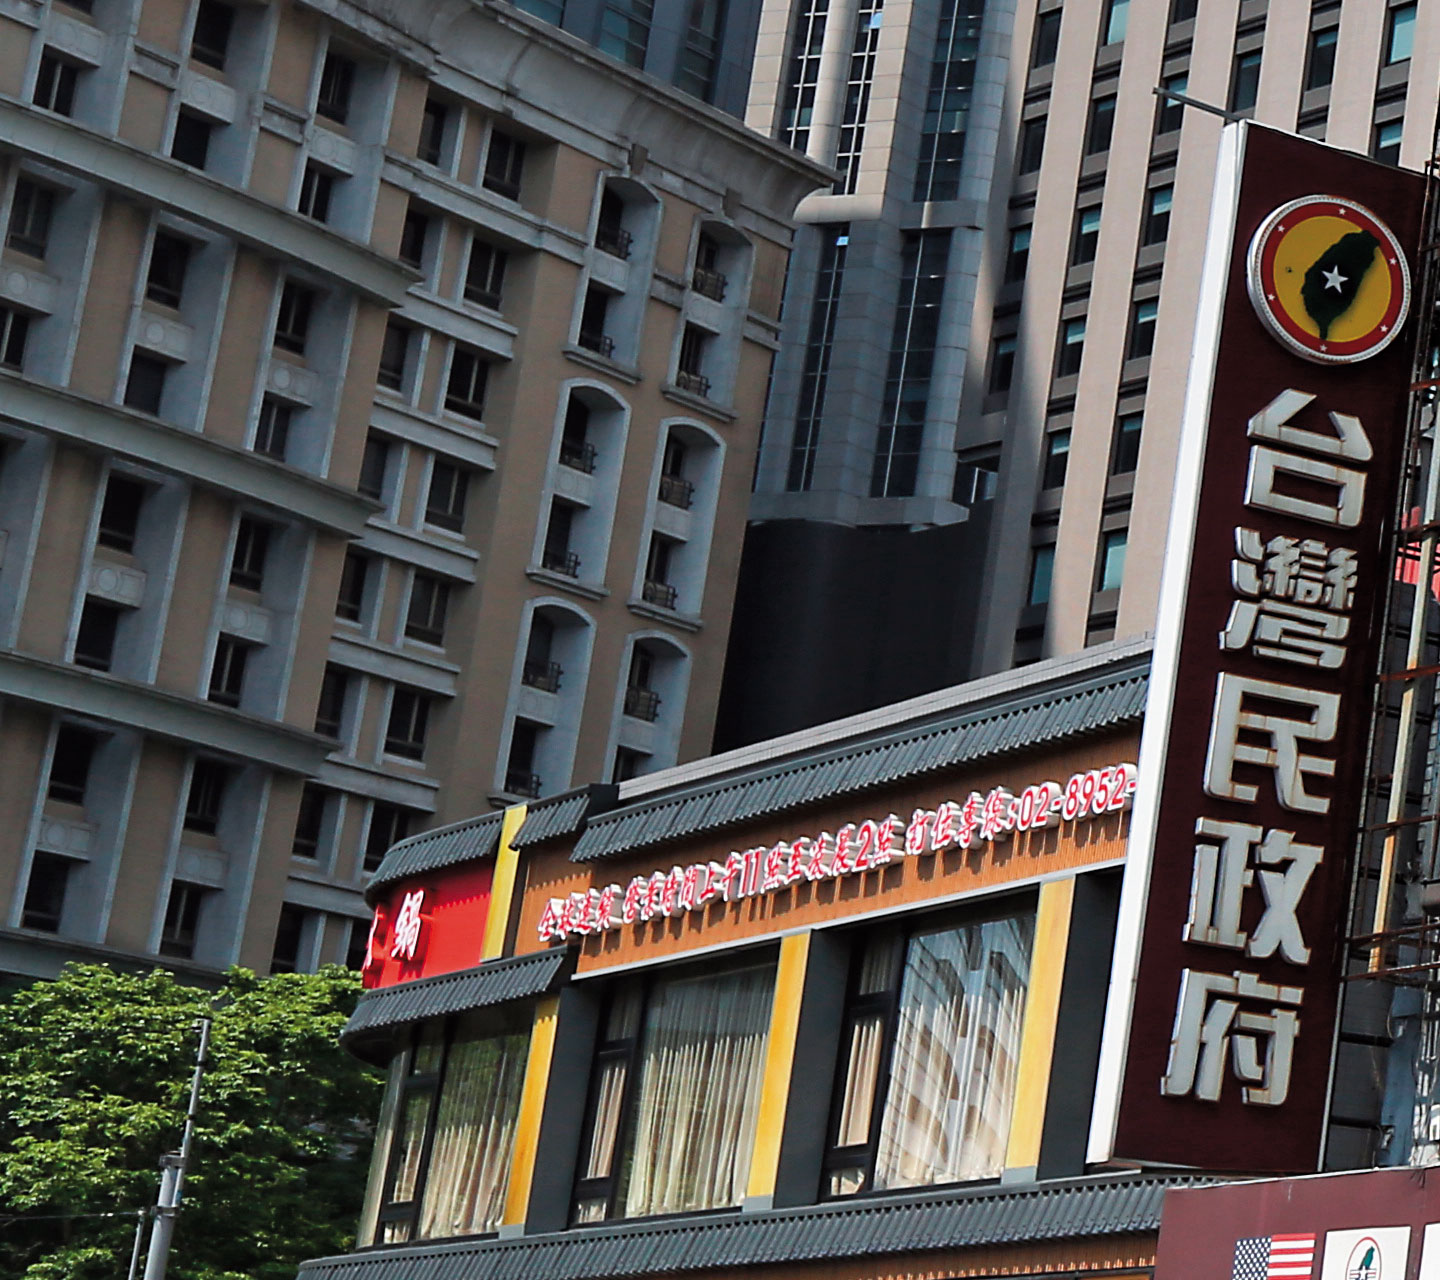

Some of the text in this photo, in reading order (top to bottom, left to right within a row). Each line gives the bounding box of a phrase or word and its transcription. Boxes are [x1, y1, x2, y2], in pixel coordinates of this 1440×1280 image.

[1160, 388, 1374, 1107] 台灣民政府
